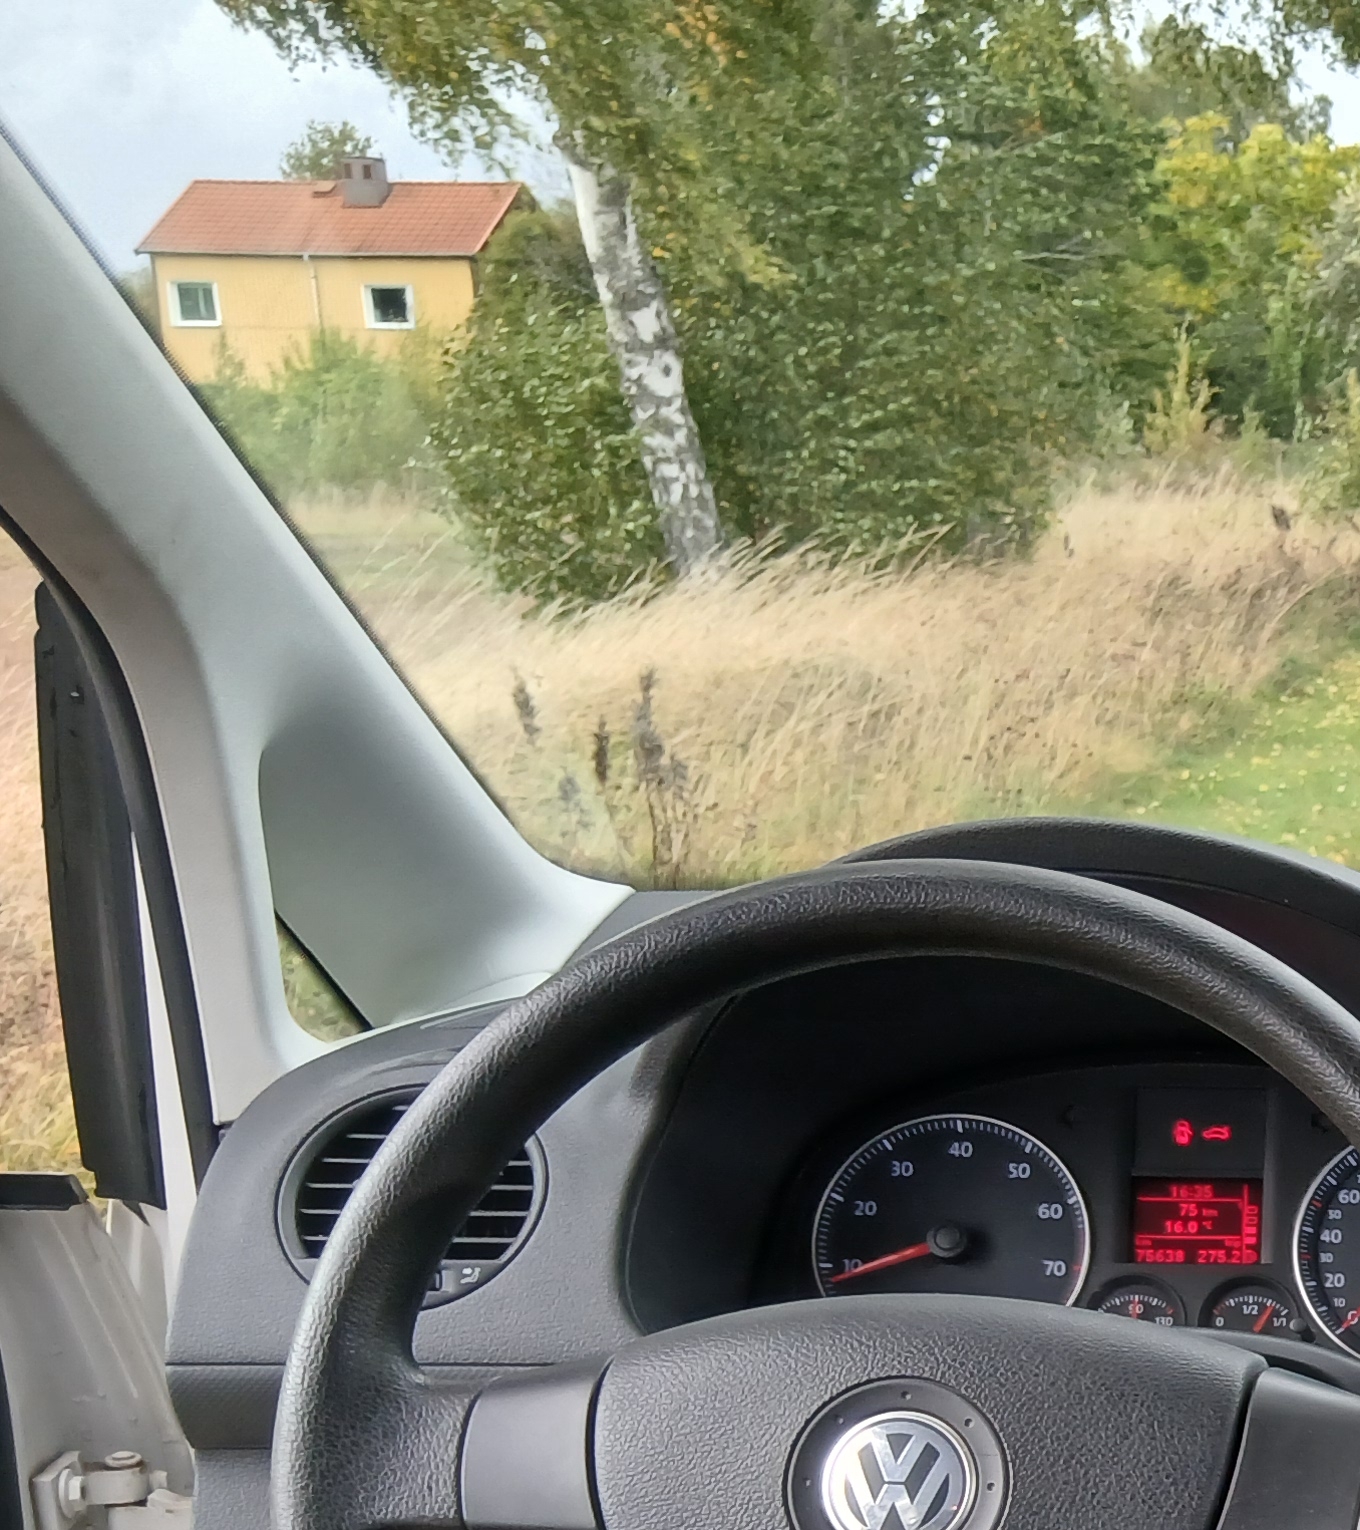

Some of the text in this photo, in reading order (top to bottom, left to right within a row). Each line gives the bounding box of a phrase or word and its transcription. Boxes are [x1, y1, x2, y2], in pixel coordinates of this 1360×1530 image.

[948, 1141, 973, 1158] 40
[890, 1160, 914, 1177] 30
[1008, 1161, 1031, 1179] 50
[1338, 1189, 1360, 1204] 60
[853, 1200, 878, 1216] 20
[1037, 1202, 1063, 1220] 60
[1179, 1203, 1198, 1217] 75
[1327, 1209, 1342, 1220] 50
[1164, 1220, 1199, 1234] 16.0
[1320, 1229, 1343, 1244] 40
[1197, 1250, 1241, 1263] 275.2
[1319, 1252, 1334, 1263] 30
[843, 1258, 864, 1274] 10
[1041, 1260, 1067, 1277] 70
[1324, 1272, 1346, 1288] 20
[1128, 1304, 1144, 1314] 90
[1242, 1304, 1259, 1315] 1/2
[1333, 1297, 1346, 1308] 10
[1154, 1316, 1174, 1326] 130
[1215, 1317, 1225, 1327] 0
